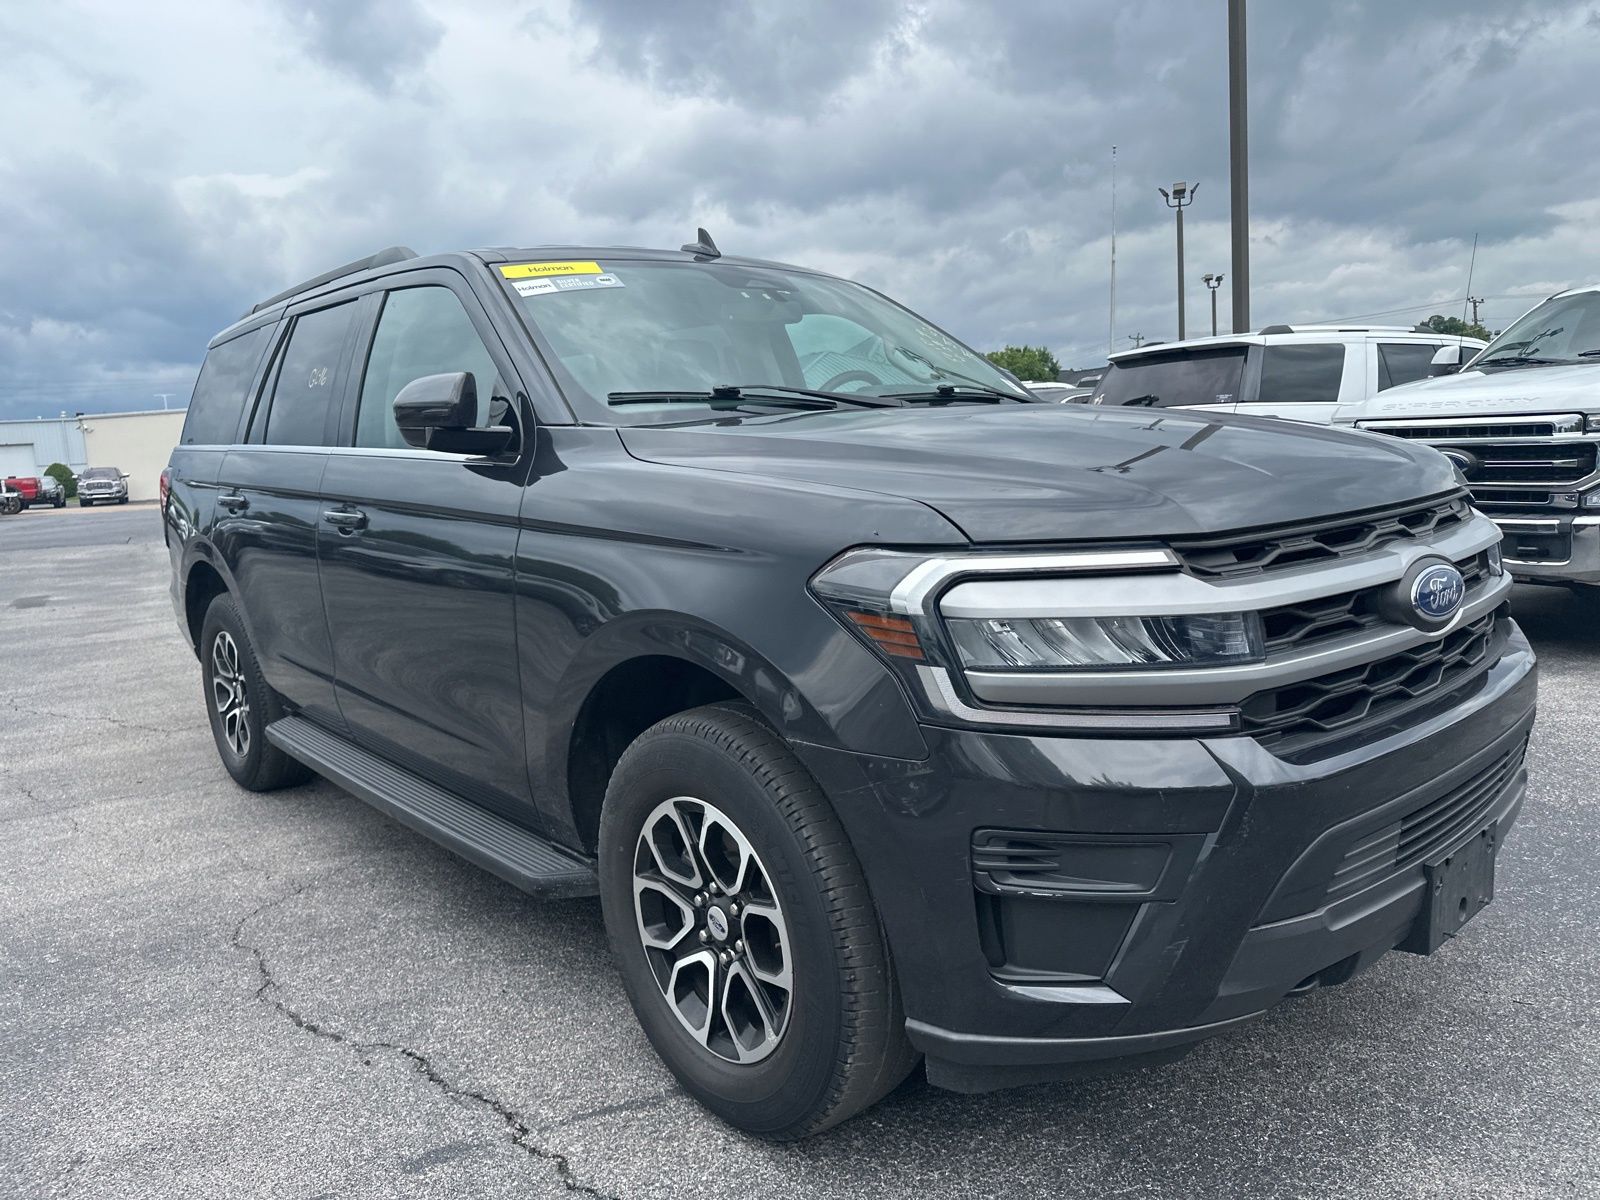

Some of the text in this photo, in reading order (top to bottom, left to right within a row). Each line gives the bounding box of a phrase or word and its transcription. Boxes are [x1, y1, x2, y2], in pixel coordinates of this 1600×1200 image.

[528, 265, 574, 273] Holman
[517, 283, 552, 292] Holman
[1429, 576, 1459, 610] Ford
